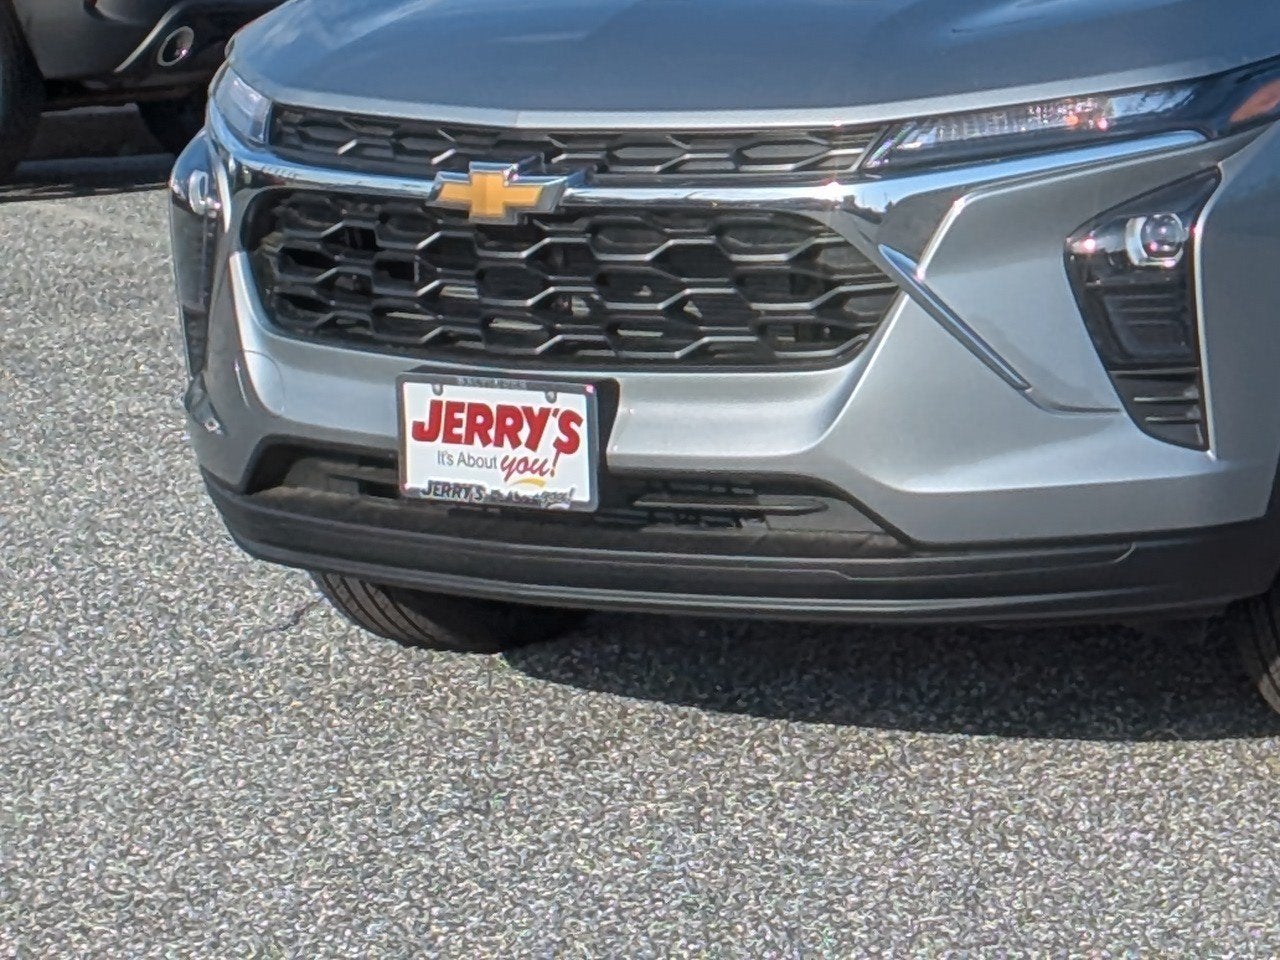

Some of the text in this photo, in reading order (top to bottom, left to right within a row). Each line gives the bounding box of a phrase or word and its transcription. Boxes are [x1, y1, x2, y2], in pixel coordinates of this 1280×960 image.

[411, 399, 583, 455] JERRY'S
[437, 449, 560, 483] It's About you!
